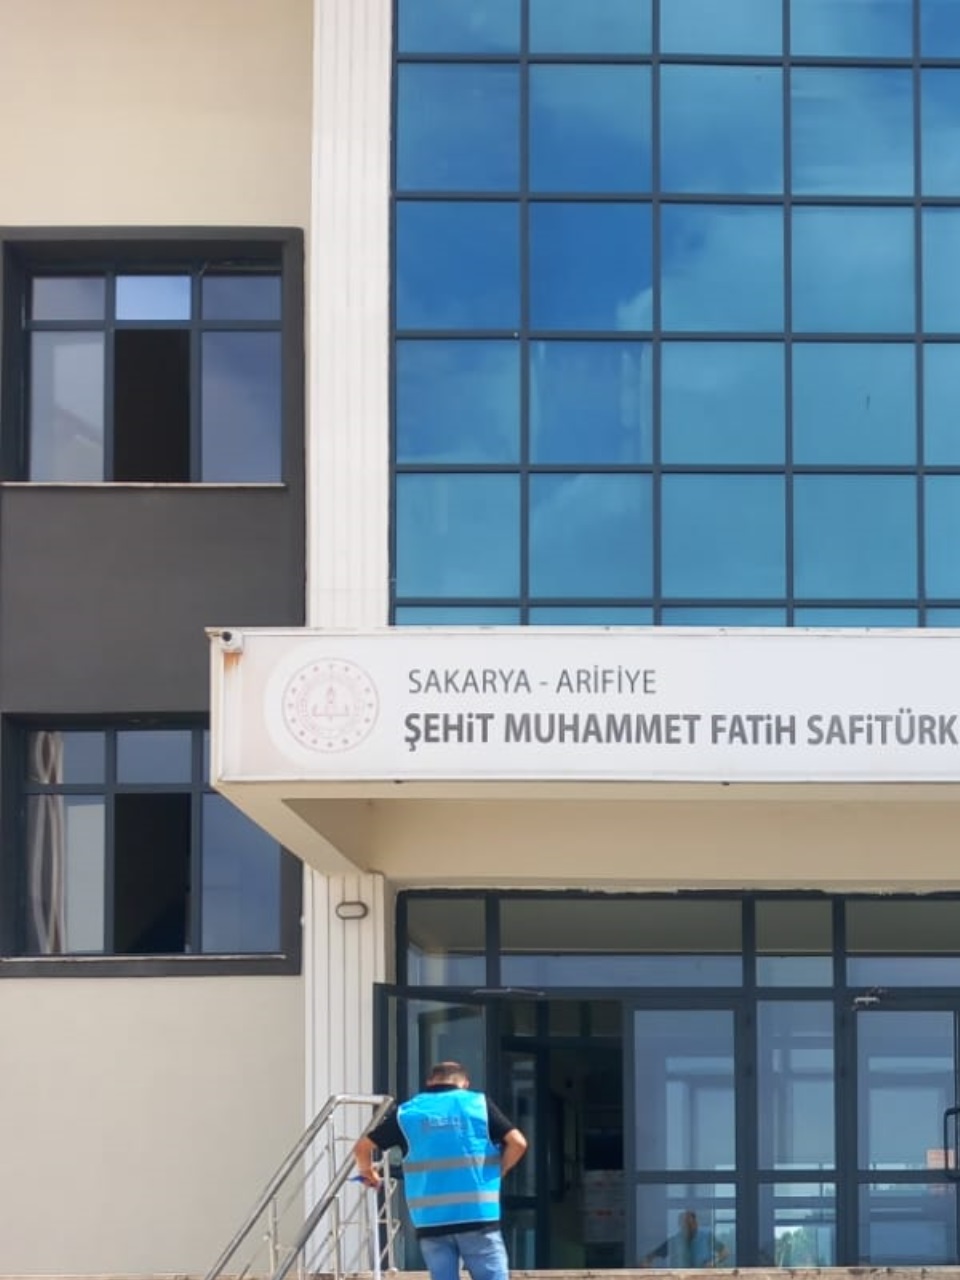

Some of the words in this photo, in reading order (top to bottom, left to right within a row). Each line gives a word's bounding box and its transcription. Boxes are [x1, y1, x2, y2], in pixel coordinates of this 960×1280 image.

[408, 668, 532, 694] SAKARYA
[555, 664, 658, 695] ARİFİYE
[504, 712, 702, 745] MUHAMMET
